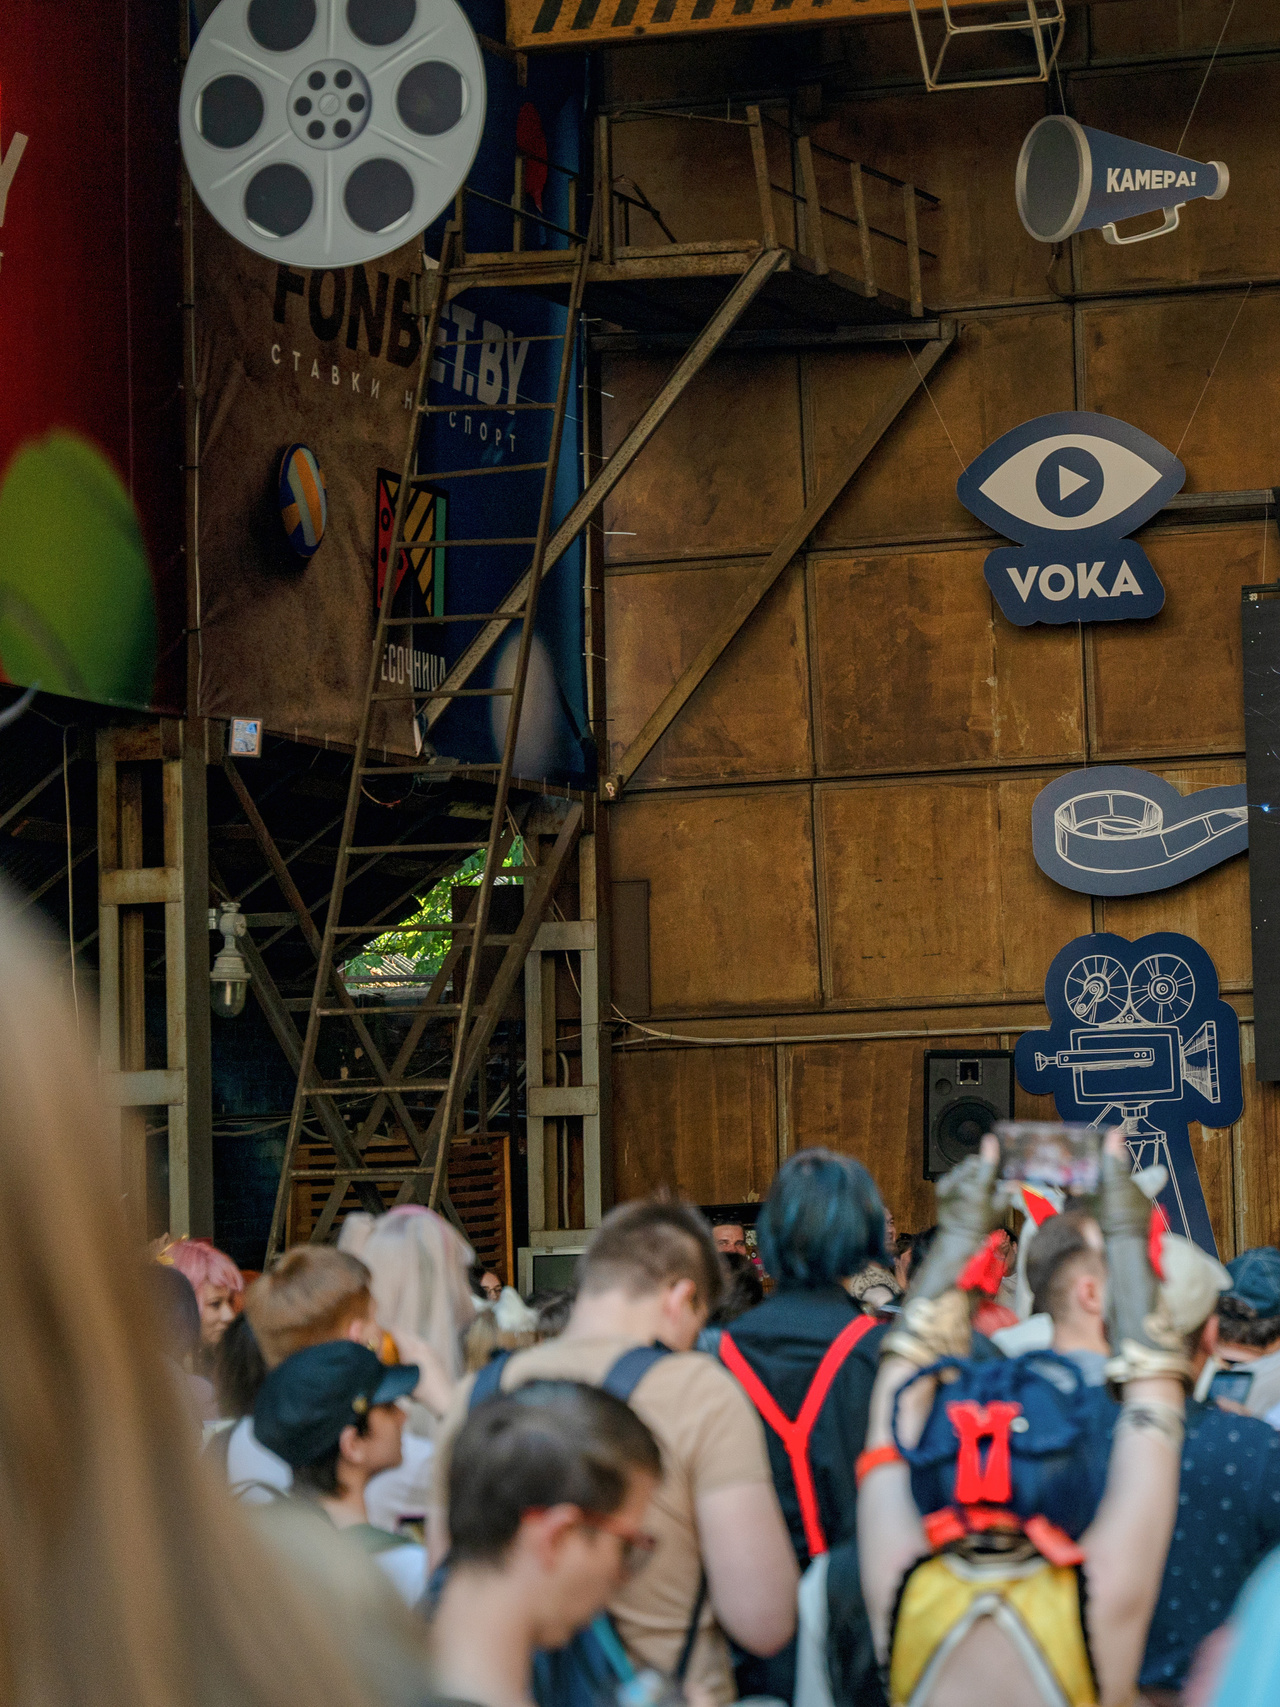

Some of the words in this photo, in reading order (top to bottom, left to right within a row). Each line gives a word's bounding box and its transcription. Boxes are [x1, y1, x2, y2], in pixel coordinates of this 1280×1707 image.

[1106, 167, 1197, 193] КАМЕРА!
[270, 344, 380, 399] СТАВКИ
[449, 410, 516, 453] СПОРТ
[1006, 559, 1144, 604] VOKA
